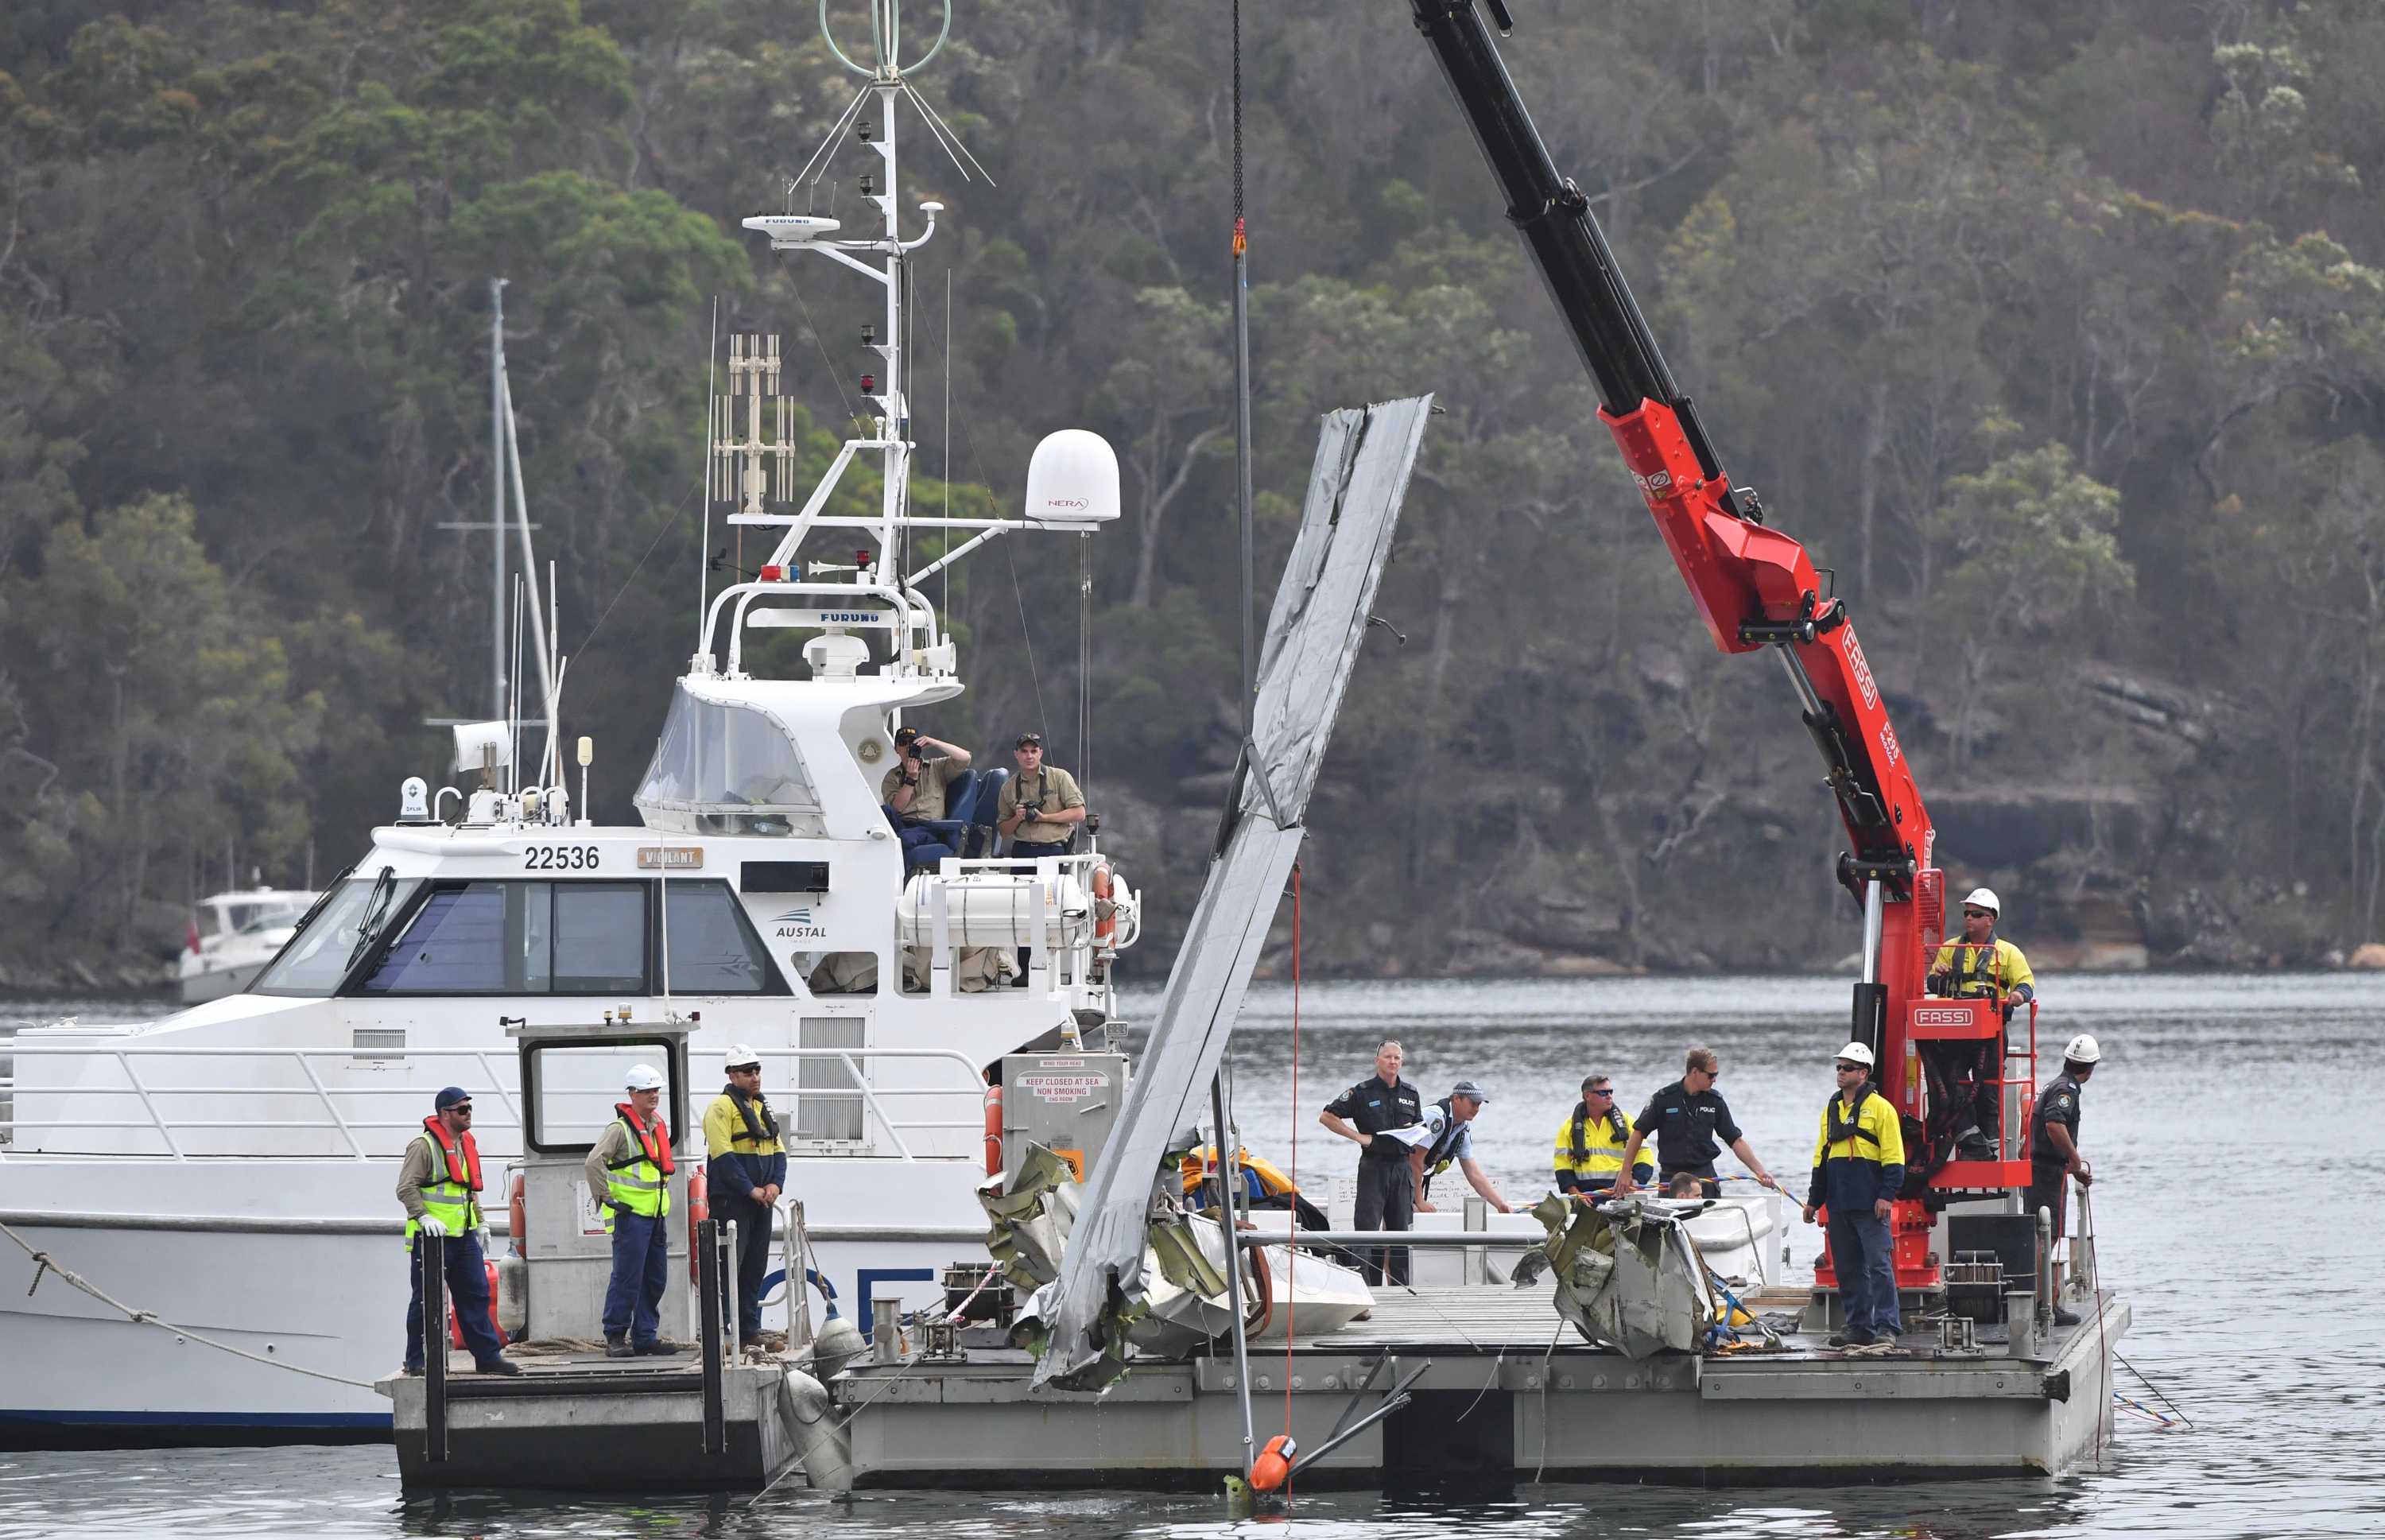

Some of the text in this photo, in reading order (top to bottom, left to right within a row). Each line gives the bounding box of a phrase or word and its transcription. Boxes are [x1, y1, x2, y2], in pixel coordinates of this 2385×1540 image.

[820, 613, 879, 623] FURUNO
[1844, 631, 1877, 704] FASSI
[1883, 720, 1900, 759] F295
[525, 846, 599, 870] 22536
[776, 927, 827, 937] AUSTAL
[1919, 1011, 1969, 1023] FASSI
